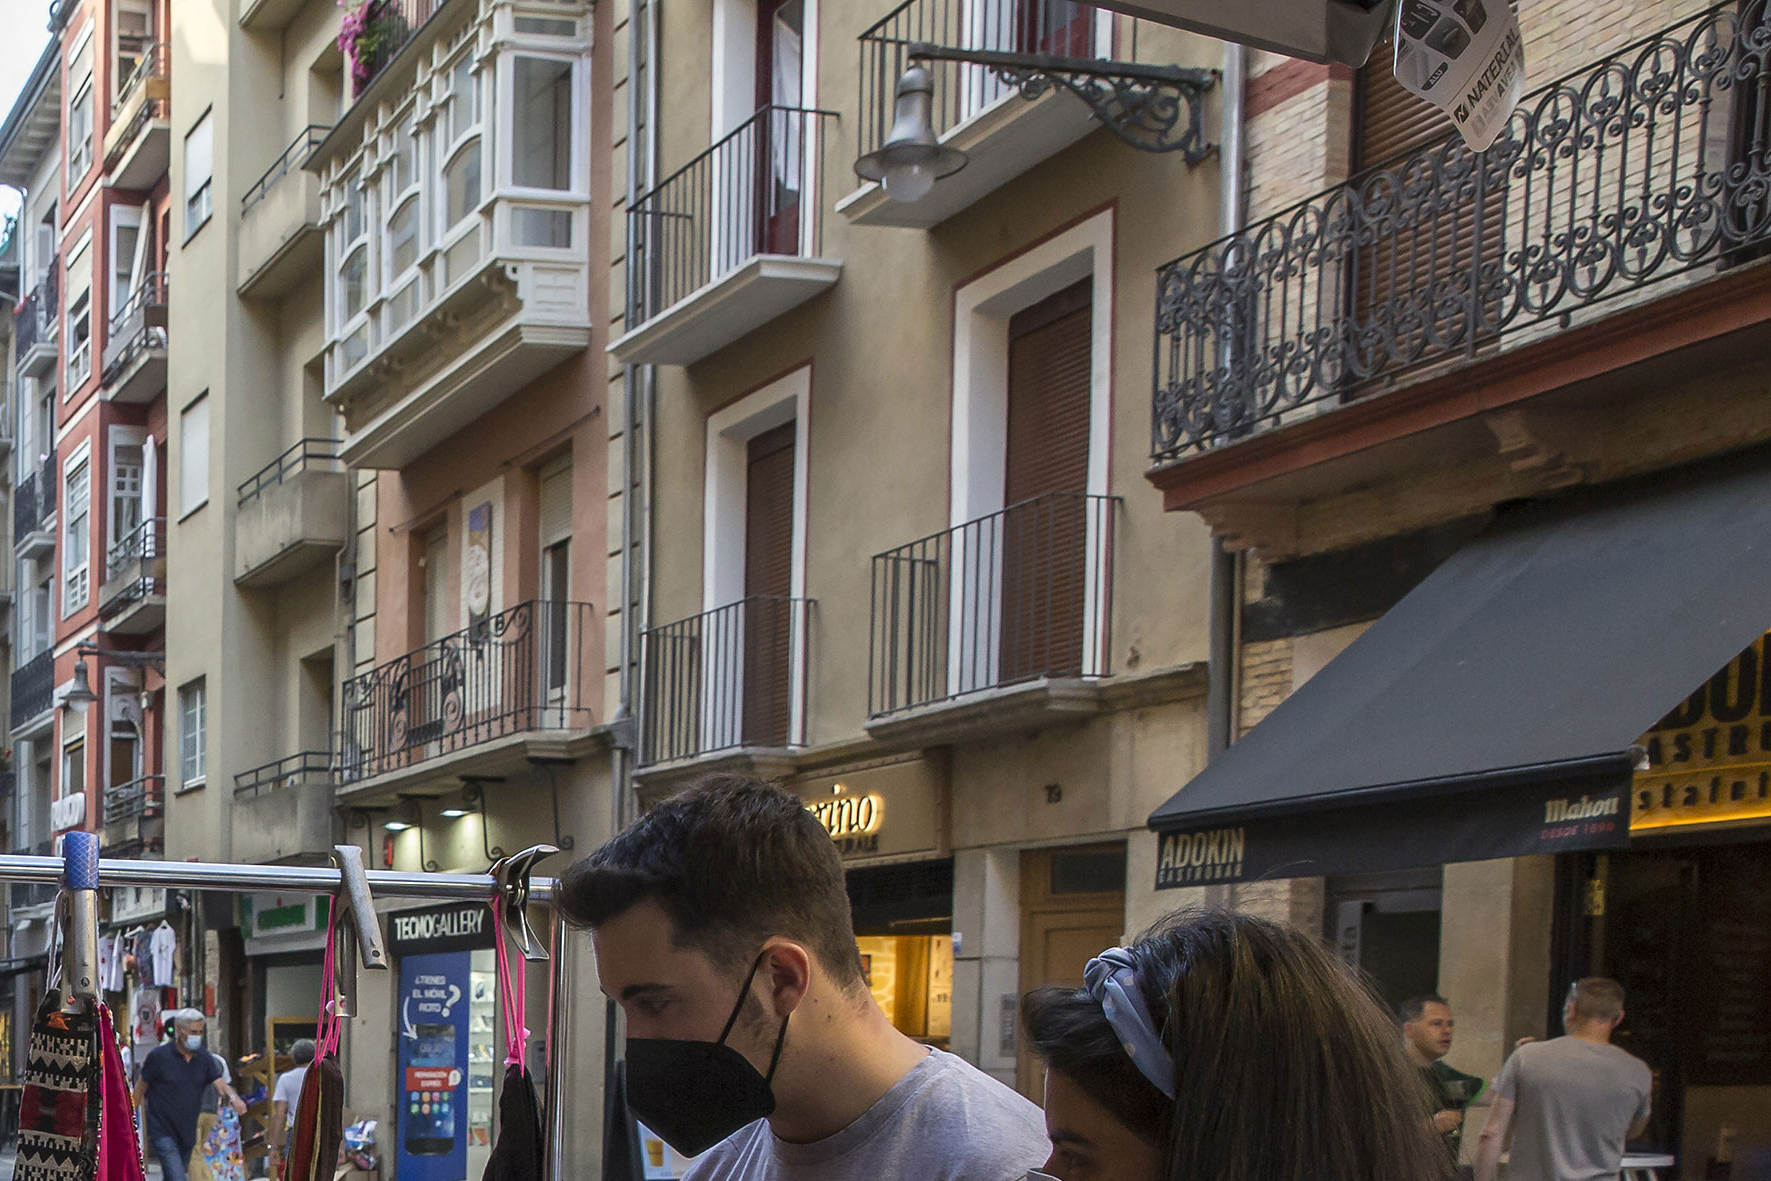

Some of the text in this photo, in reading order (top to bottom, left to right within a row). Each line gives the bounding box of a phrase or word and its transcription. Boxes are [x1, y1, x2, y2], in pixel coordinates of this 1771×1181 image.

[1466, 28, 1520, 108] NATERIAL
[1544, 795, 1619, 824] Mahou
[1159, 827, 1244, 870] ADOKIN
[394, 908, 485, 941] TECNOGALLERY
